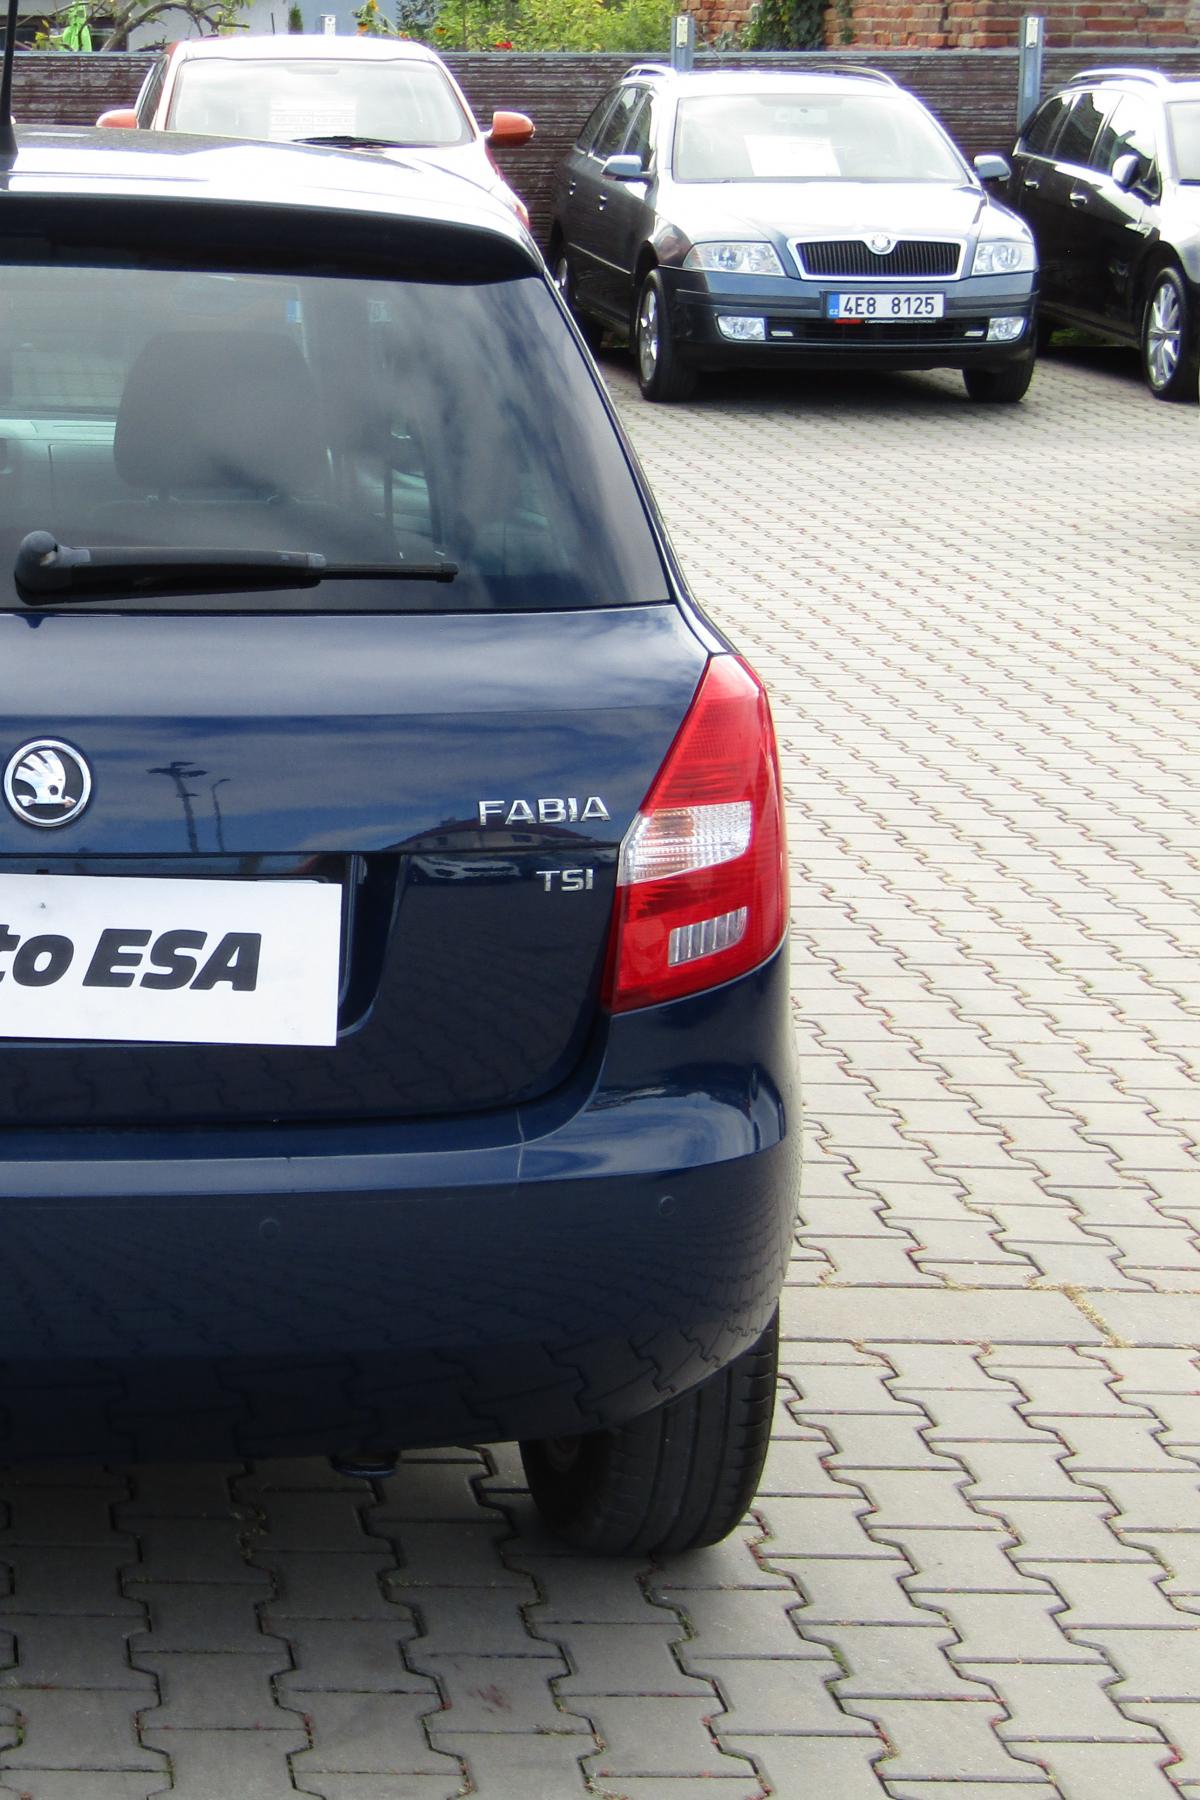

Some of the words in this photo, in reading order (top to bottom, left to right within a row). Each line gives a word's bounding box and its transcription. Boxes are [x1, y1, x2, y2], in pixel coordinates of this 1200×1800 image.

[843, 297, 876, 315] 4E8
[891, 297, 935, 315] 8125
[478, 796, 612, 826] FABIA
[536, 868, 594, 892] TSI
[82, 928, 262, 991] ESA
